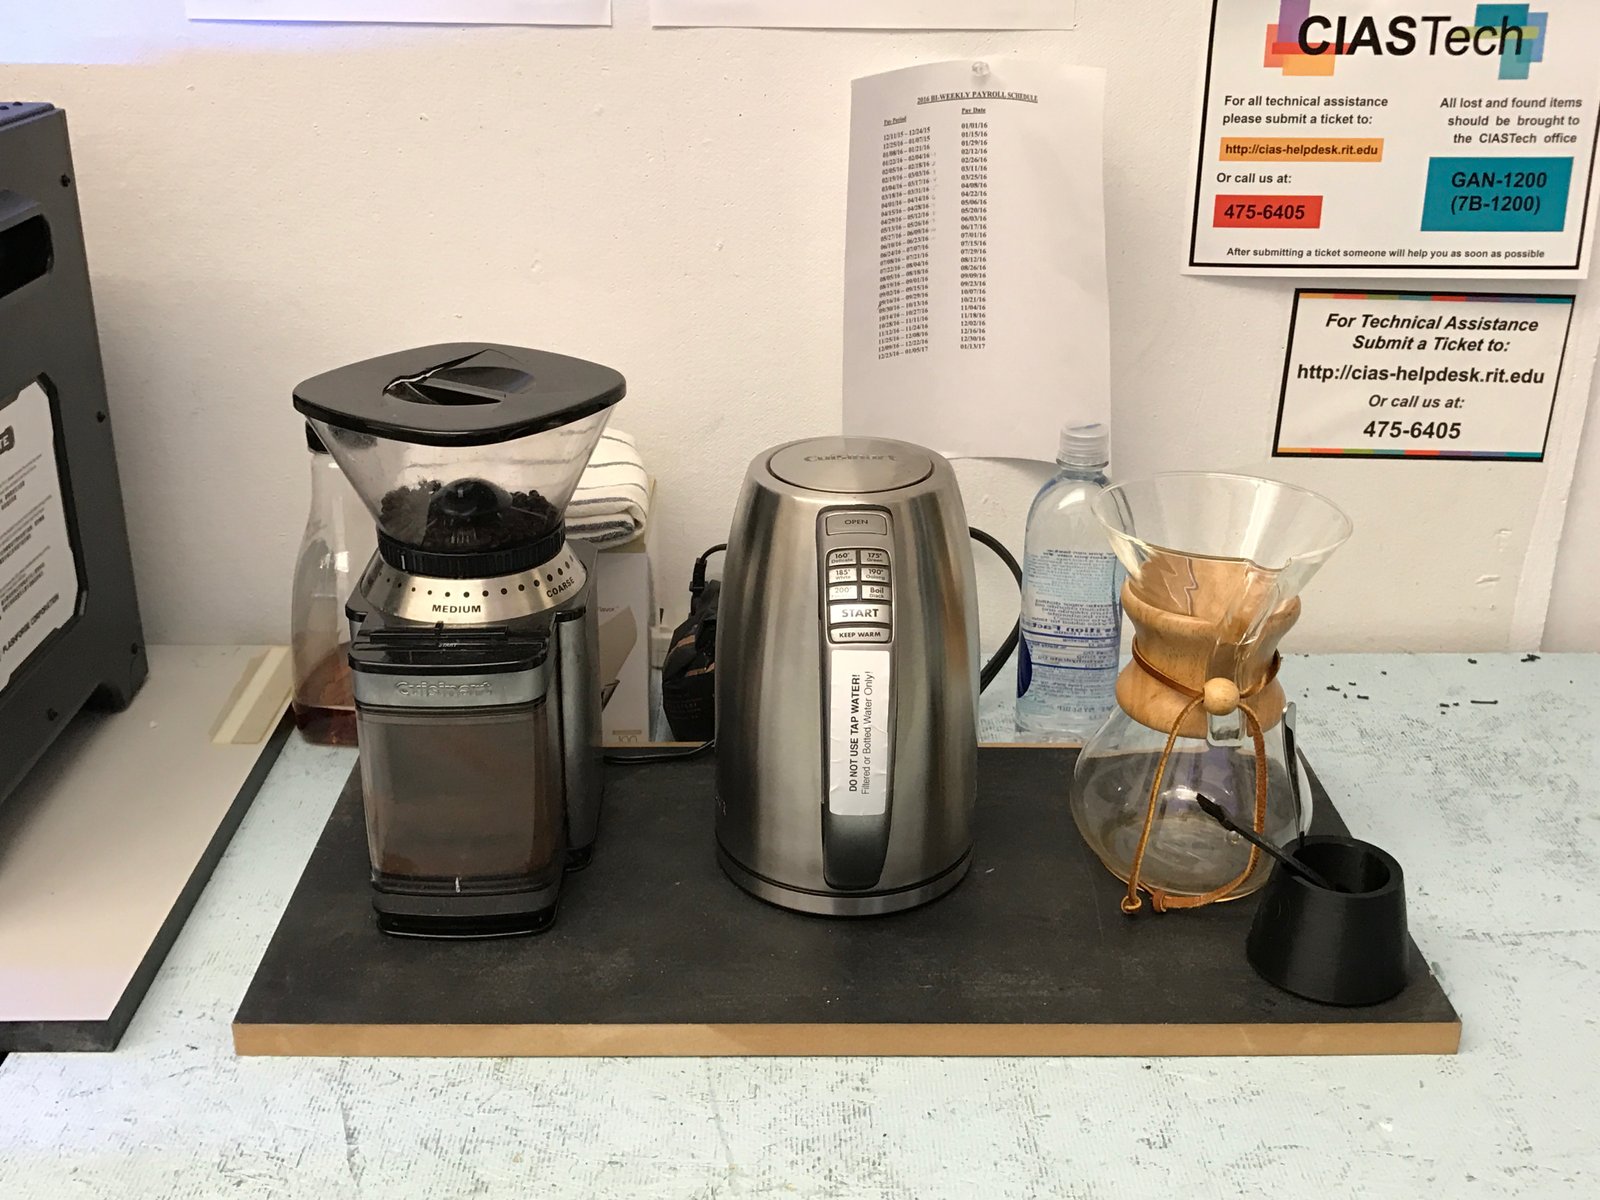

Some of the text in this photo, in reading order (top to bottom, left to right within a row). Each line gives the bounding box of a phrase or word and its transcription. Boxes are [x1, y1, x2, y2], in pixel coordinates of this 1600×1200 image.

[1298, 15, 1523, 56] CIASTech
[972, 91, 1006, 100] PAYROLL
[1007, 92, 1038, 103] SCHEDULE
[1224, 96, 1388, 107] For all technical assistance
[1440, 98, 1582, 109] All lost and found items
[1222, 113, 1373, 127] please submit a ticket to:
[1447, 115, 1580, 130] should be brought to
[1452, 133, 1578, 144] the CIASTech office
[1225, 143, 1379, 158] http://cias-helpdesk.rit.edu
[1216, 172, 1292, 184] Or call us at:
[1451, 171, 1548, 189] GAN-1200
[1224, 204, 1306, 220] 475-6405
[1450, 195, 1541, 216] (7B-1200)
[1226, 248, 1545, 261] After submitting a ticket someone will help you as soon as possible
[1325, 313, 1539, 332] For Technical Assistance
[1352, 335, 1511, 352] Submit a Ticket to:
[1297, 364, 1545, 385] http://cias-helpdesk.rit.edu
[1368, 394, 1465, 409] Or call us at:
[1363, 420, 1462, 439] 475-6405
[844, 518, 869, 526] OPEN
[546, 576, 575, 598] COARSE
[869, 586, 884, 594] Boil
[431, 604, 482, 613] MEDIUM
[841, 608, 879, 618] START
[395, 681, 492, 697] Cuisinart
[863, 671, 875, 696] Only!
[863, 698, 872, 724] Water
[848, 674, 861, 792] DO NOT USE TAP WATER!
[863, 756, 871, 765] or
[861, 766, 871, 795] Filtered
